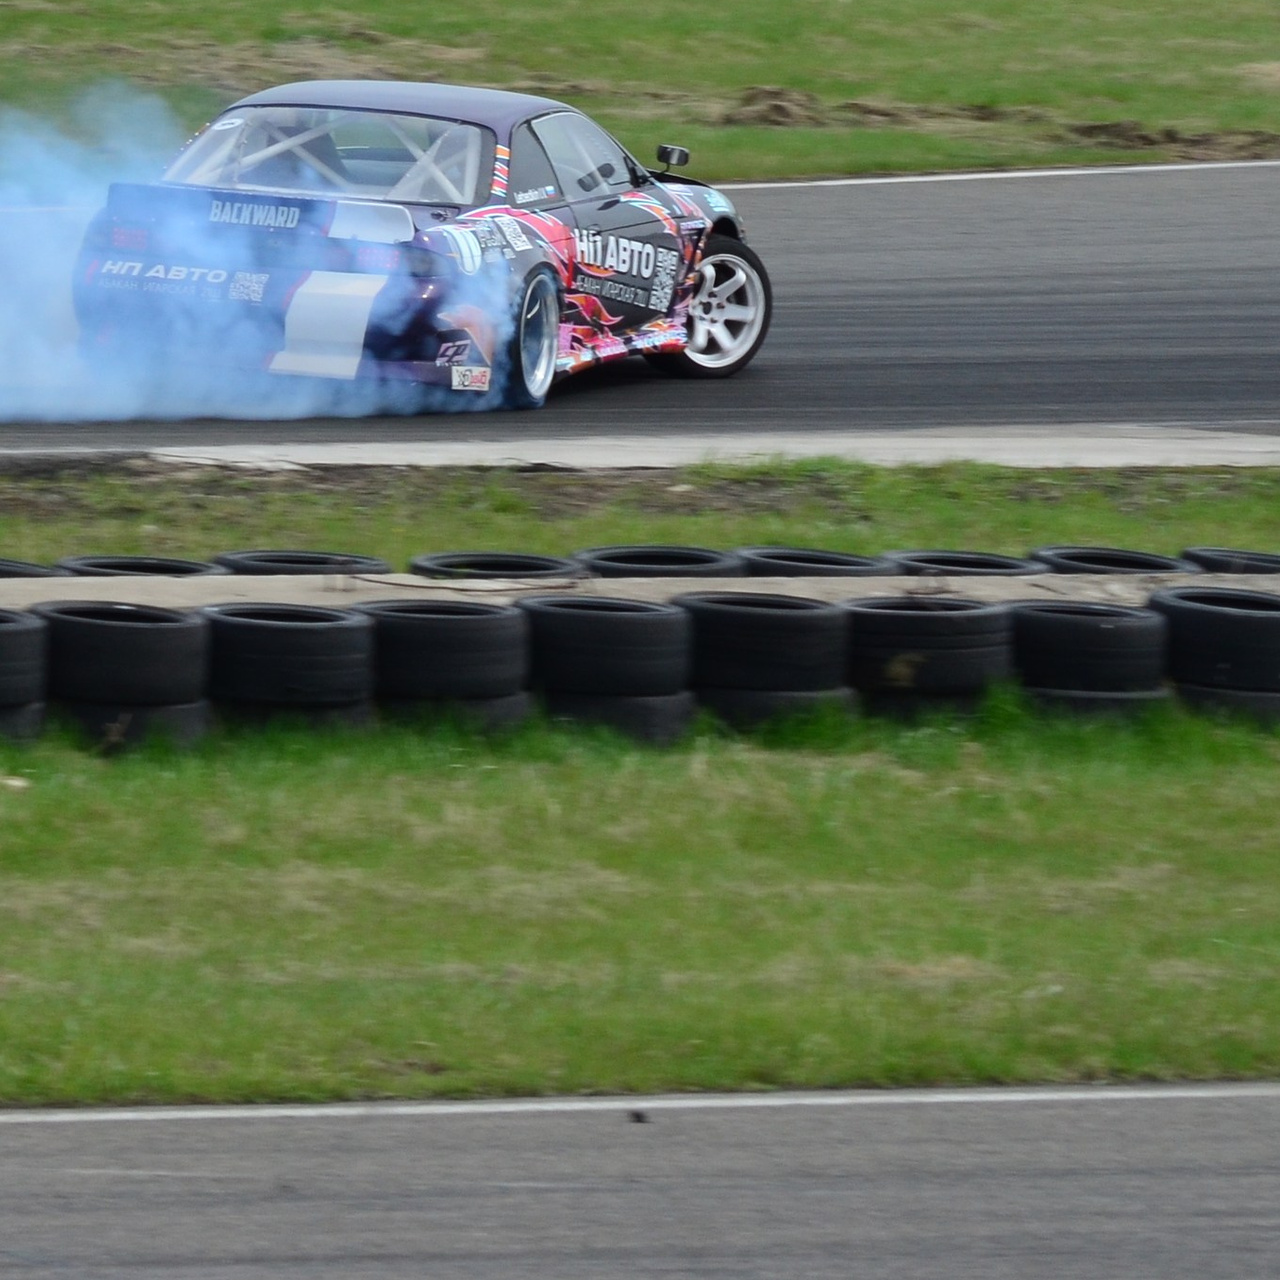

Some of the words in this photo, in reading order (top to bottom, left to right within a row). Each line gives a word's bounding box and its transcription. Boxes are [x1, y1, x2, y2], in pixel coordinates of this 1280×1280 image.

[210, 200, 300, 228] BACKWARD
[604, 235, 655, 279] АВТО
[101, 260, 143, 275] НП
[145, 264, 227, 283] АВТО
